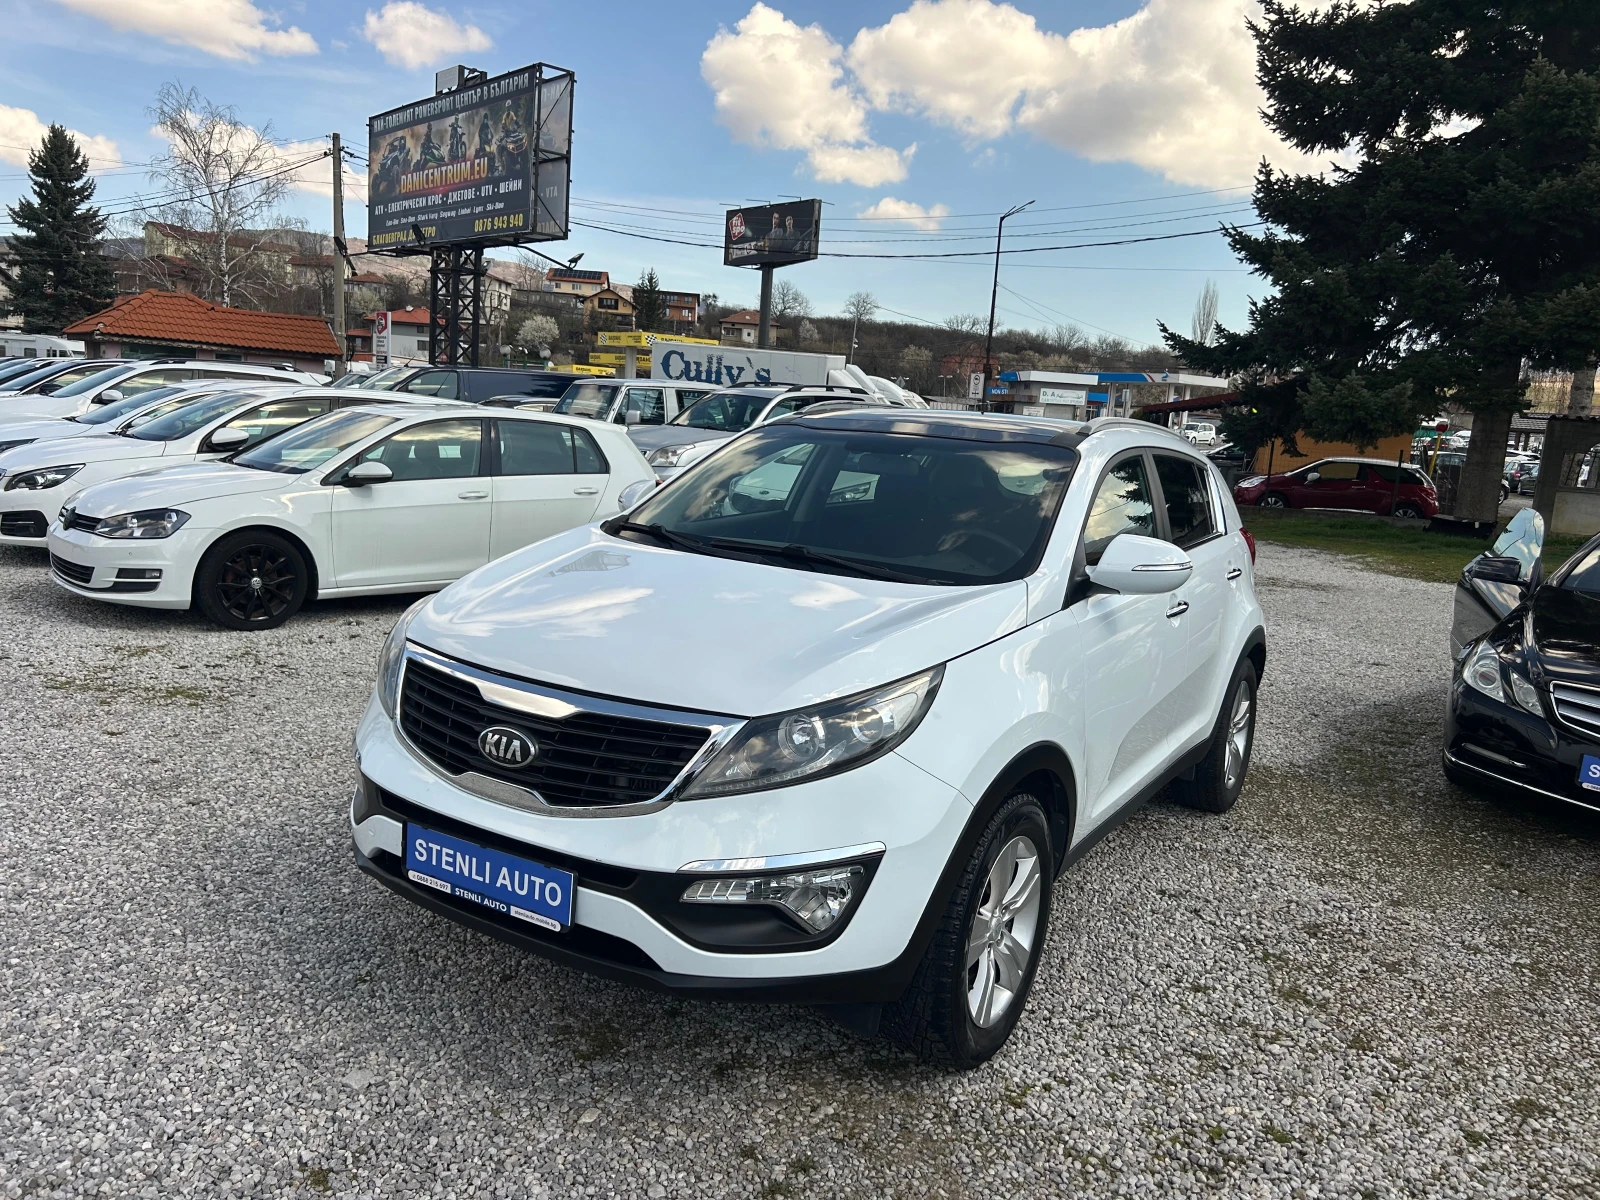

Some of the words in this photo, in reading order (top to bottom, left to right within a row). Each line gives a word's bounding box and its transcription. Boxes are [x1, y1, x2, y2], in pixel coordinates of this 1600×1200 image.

[415, 96, 454, 120] POWERSPORT
[455, 87, 481, 110] ЦЕНТЪР
[490, 72, 529, 98] БЪЛГАРИЯ
[400, 157, 489, 194] DANICENTRUM.EU
[388, 196, 427, 214] ЕЛЕКТРИЧЕСКИ
[427, 193, 442, 206] КРОС
[447, 187, 476, 205] ДЖЕТОВЕ
[481, 184, 493, 197] UTV
[499, 178, 523, 194] ШЕЙНИ
[474, 217, 492, 233] 0876
[493, 215, 508, 230] 943
[509, 213, 524, 228] 940
[485, 731, 522, 762] KIA
[414, 838, 490, 884] STENLI
[496, 866, 562, 907] AUTO
[416, 874, 429, 885] 0888
[429, 877, 439, 888] 215
[439, 880, 449, 891] 697
[455, 887, 482, 904] STENLI
[483, 898, 507, 912] AUTO
[514, 909, 557, 930] stenliauto.mobile.bg
